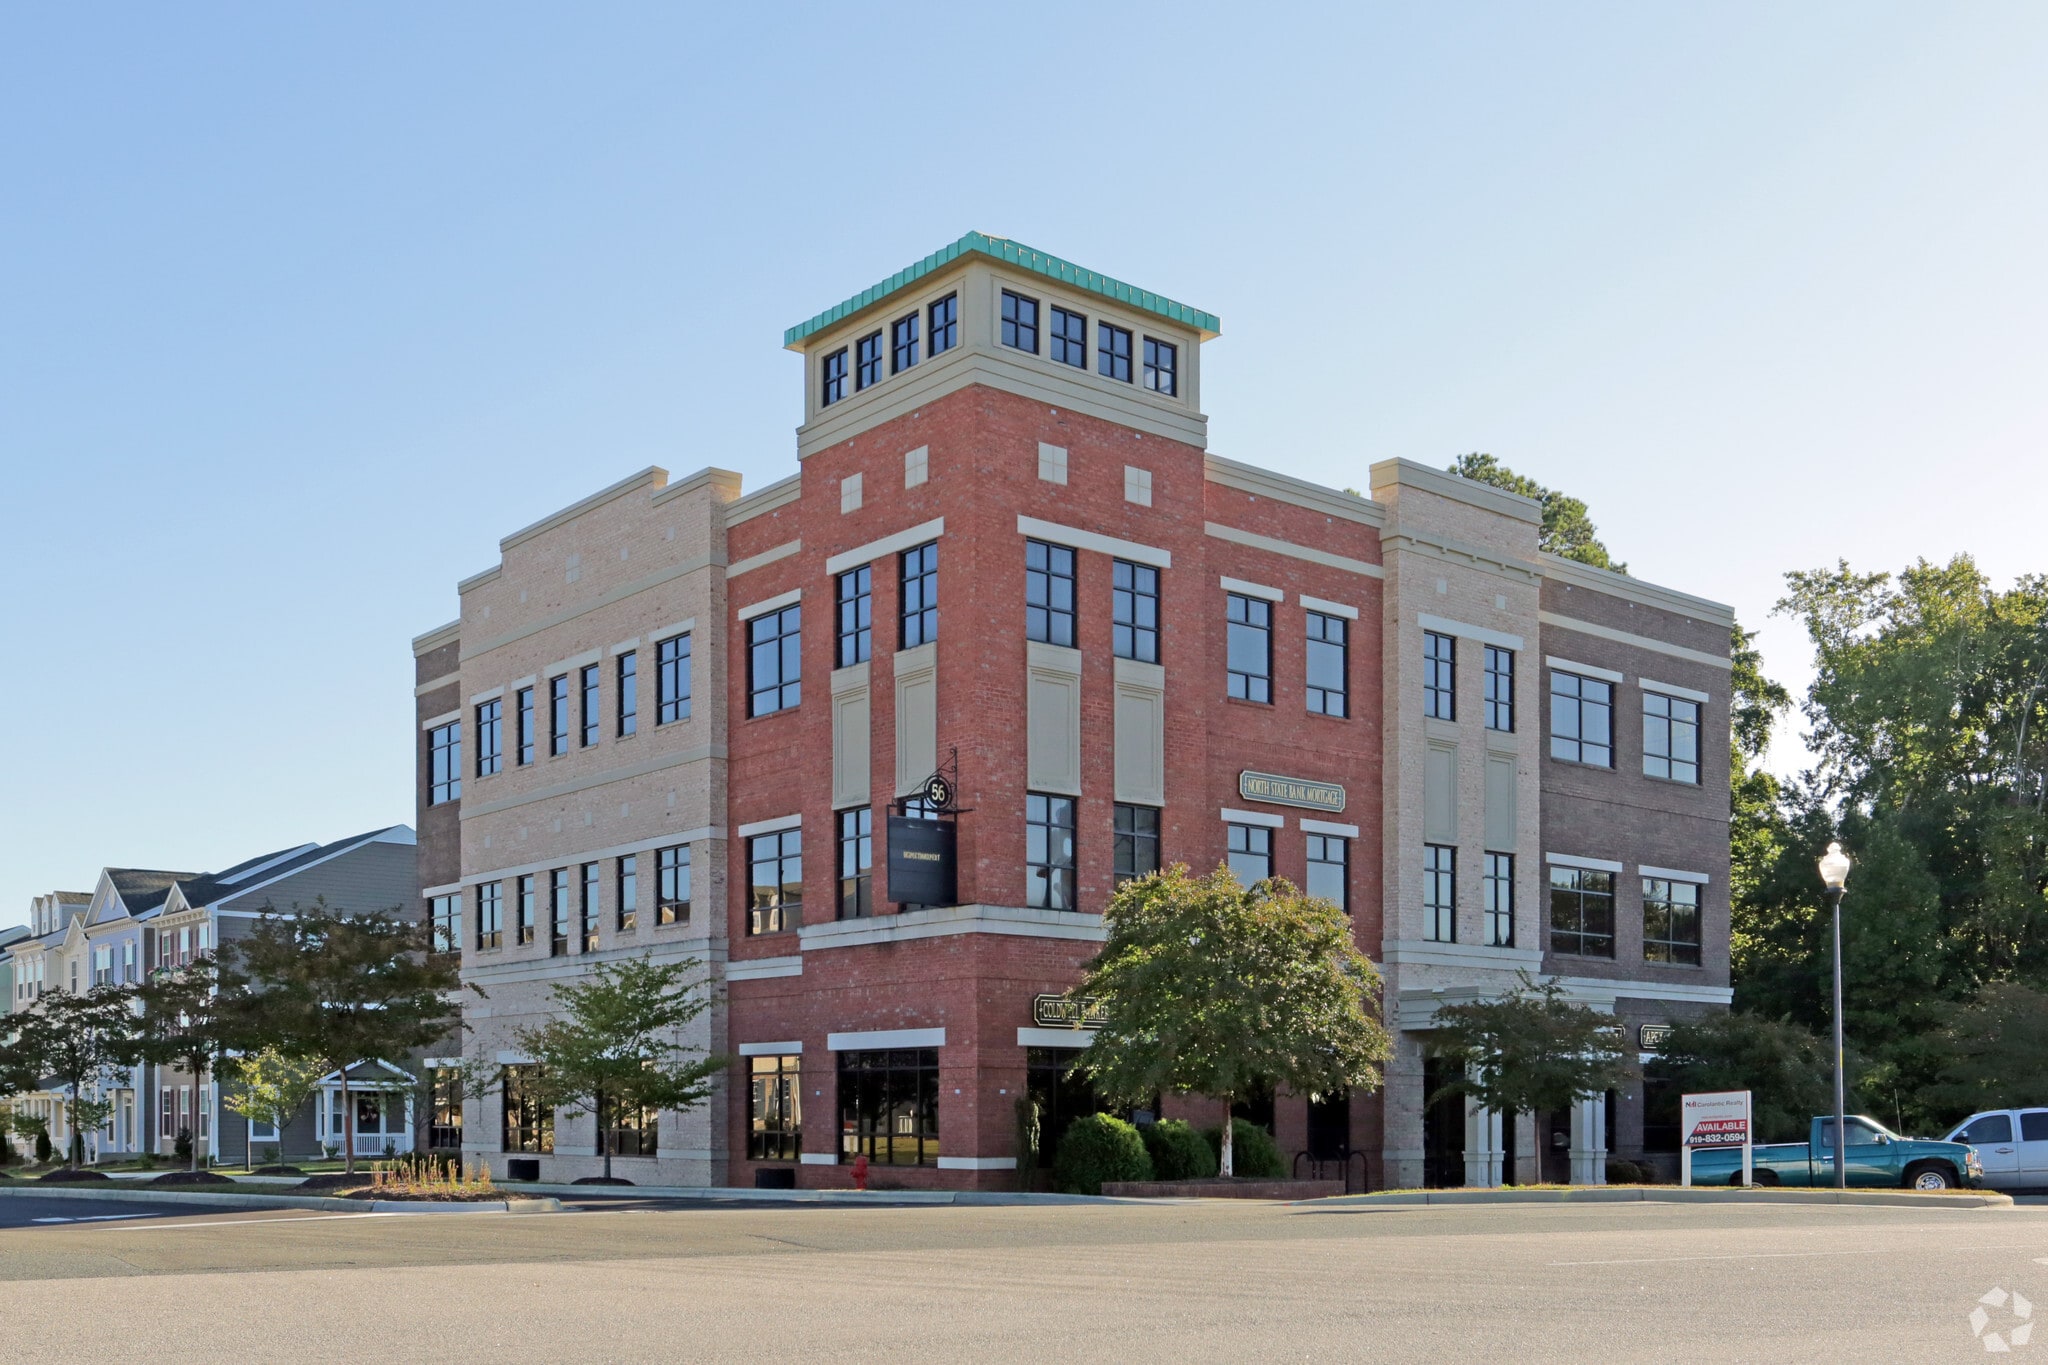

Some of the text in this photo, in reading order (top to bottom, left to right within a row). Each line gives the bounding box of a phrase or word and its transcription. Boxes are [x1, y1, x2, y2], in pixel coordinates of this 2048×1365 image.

[931, 784, 945, 801] 56
[1247, 779, 1338, 805] NORTH STATE BANK MORTGAGE
[1043, 1002, 1079, 1019] COLDWLL
[1697, 1121, 1746, 1131] AVAILABLE
[1689, 1133, 1745, 1143] 919-832-0594
